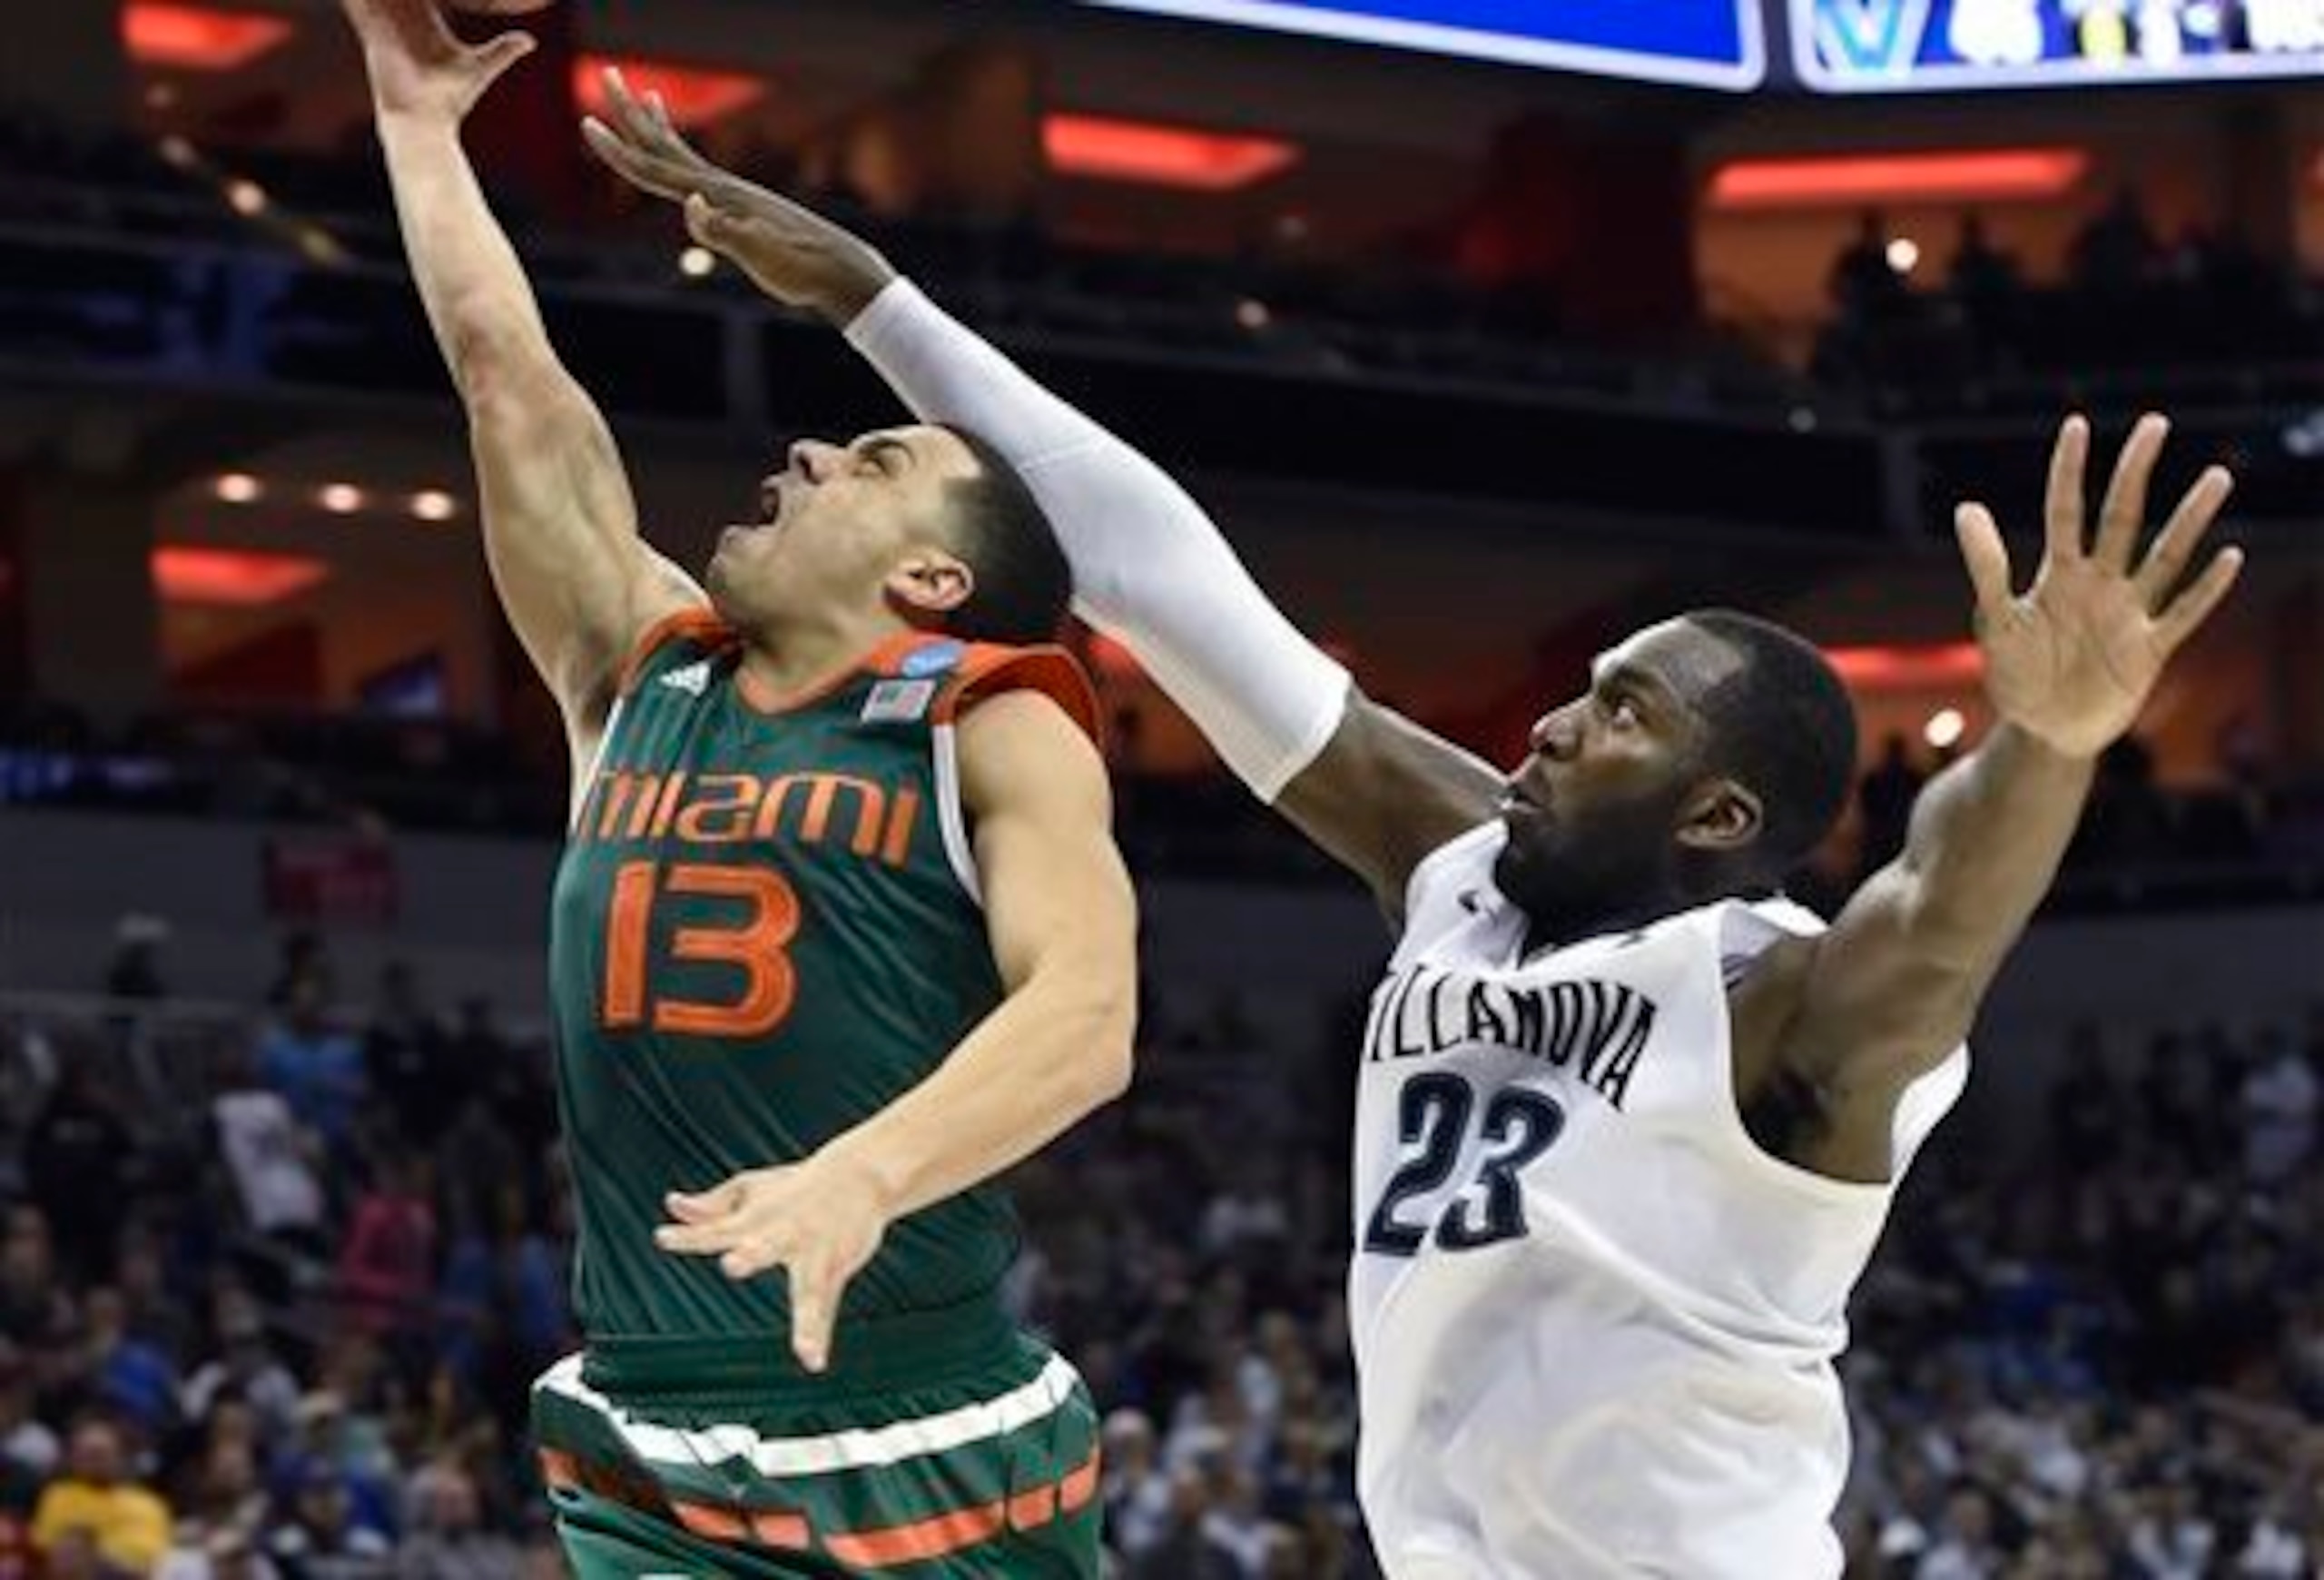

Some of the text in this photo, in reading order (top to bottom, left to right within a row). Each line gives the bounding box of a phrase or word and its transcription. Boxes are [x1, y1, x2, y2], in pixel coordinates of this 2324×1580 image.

[603, 862, 801, 1035] 13
[1370, 964, 1657, 1112] ILLANOVA
[1364, 1071, 1565, 1255] 23
